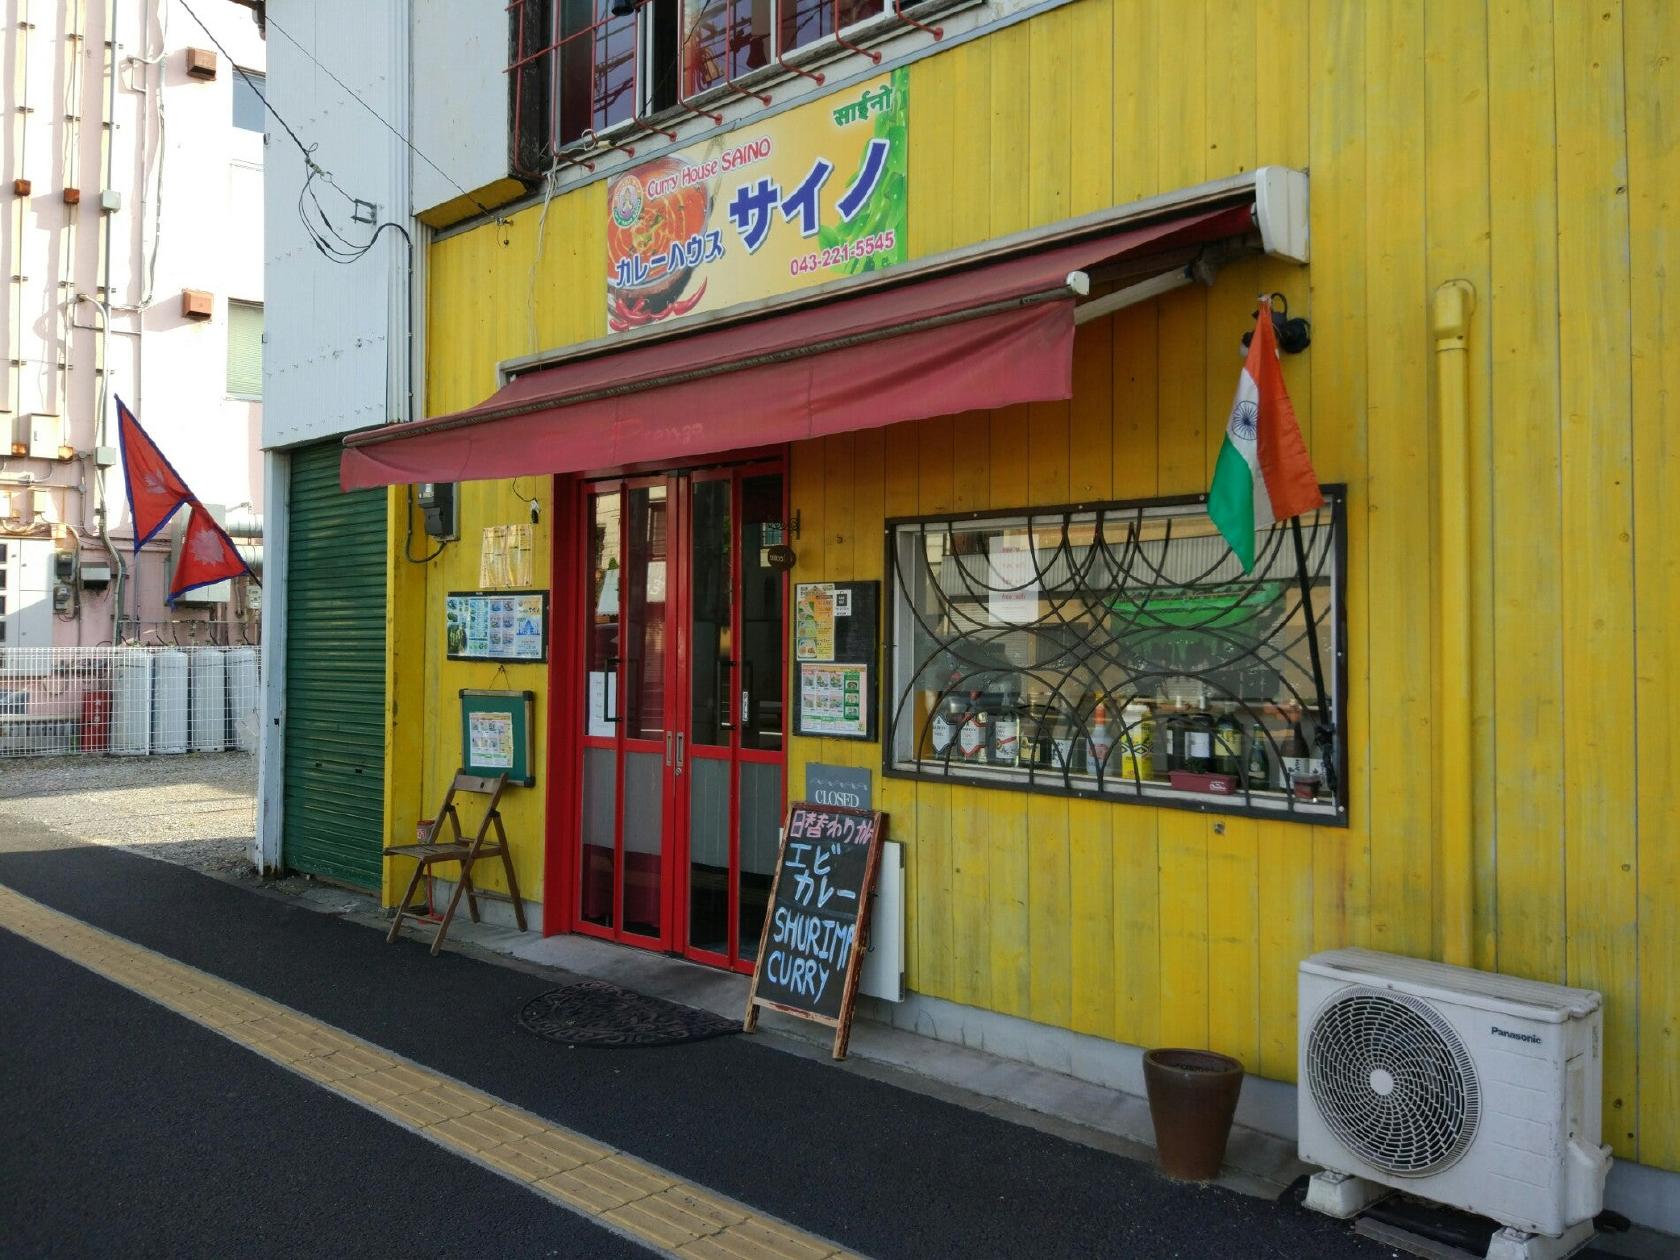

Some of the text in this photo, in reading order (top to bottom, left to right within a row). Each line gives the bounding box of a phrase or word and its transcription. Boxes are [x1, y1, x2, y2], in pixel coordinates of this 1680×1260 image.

[833, 85, 892, 126] साईनो
[647, 138, 771, 198] Curry House SAINO
[729, 141, 888, 249] サイノ
[616, 231, 724, 286] カレーハウス
[790, 232, 894, 275] 043-221-5545
[815, 789, 860, 808] CLOSED
[785, 842, 841, 875] エビ
[794, 869, 856, 908] カレー
[767, 950, 830, 1004] CURRY
[1491, 1026, 1542, 1044] Panasonic
